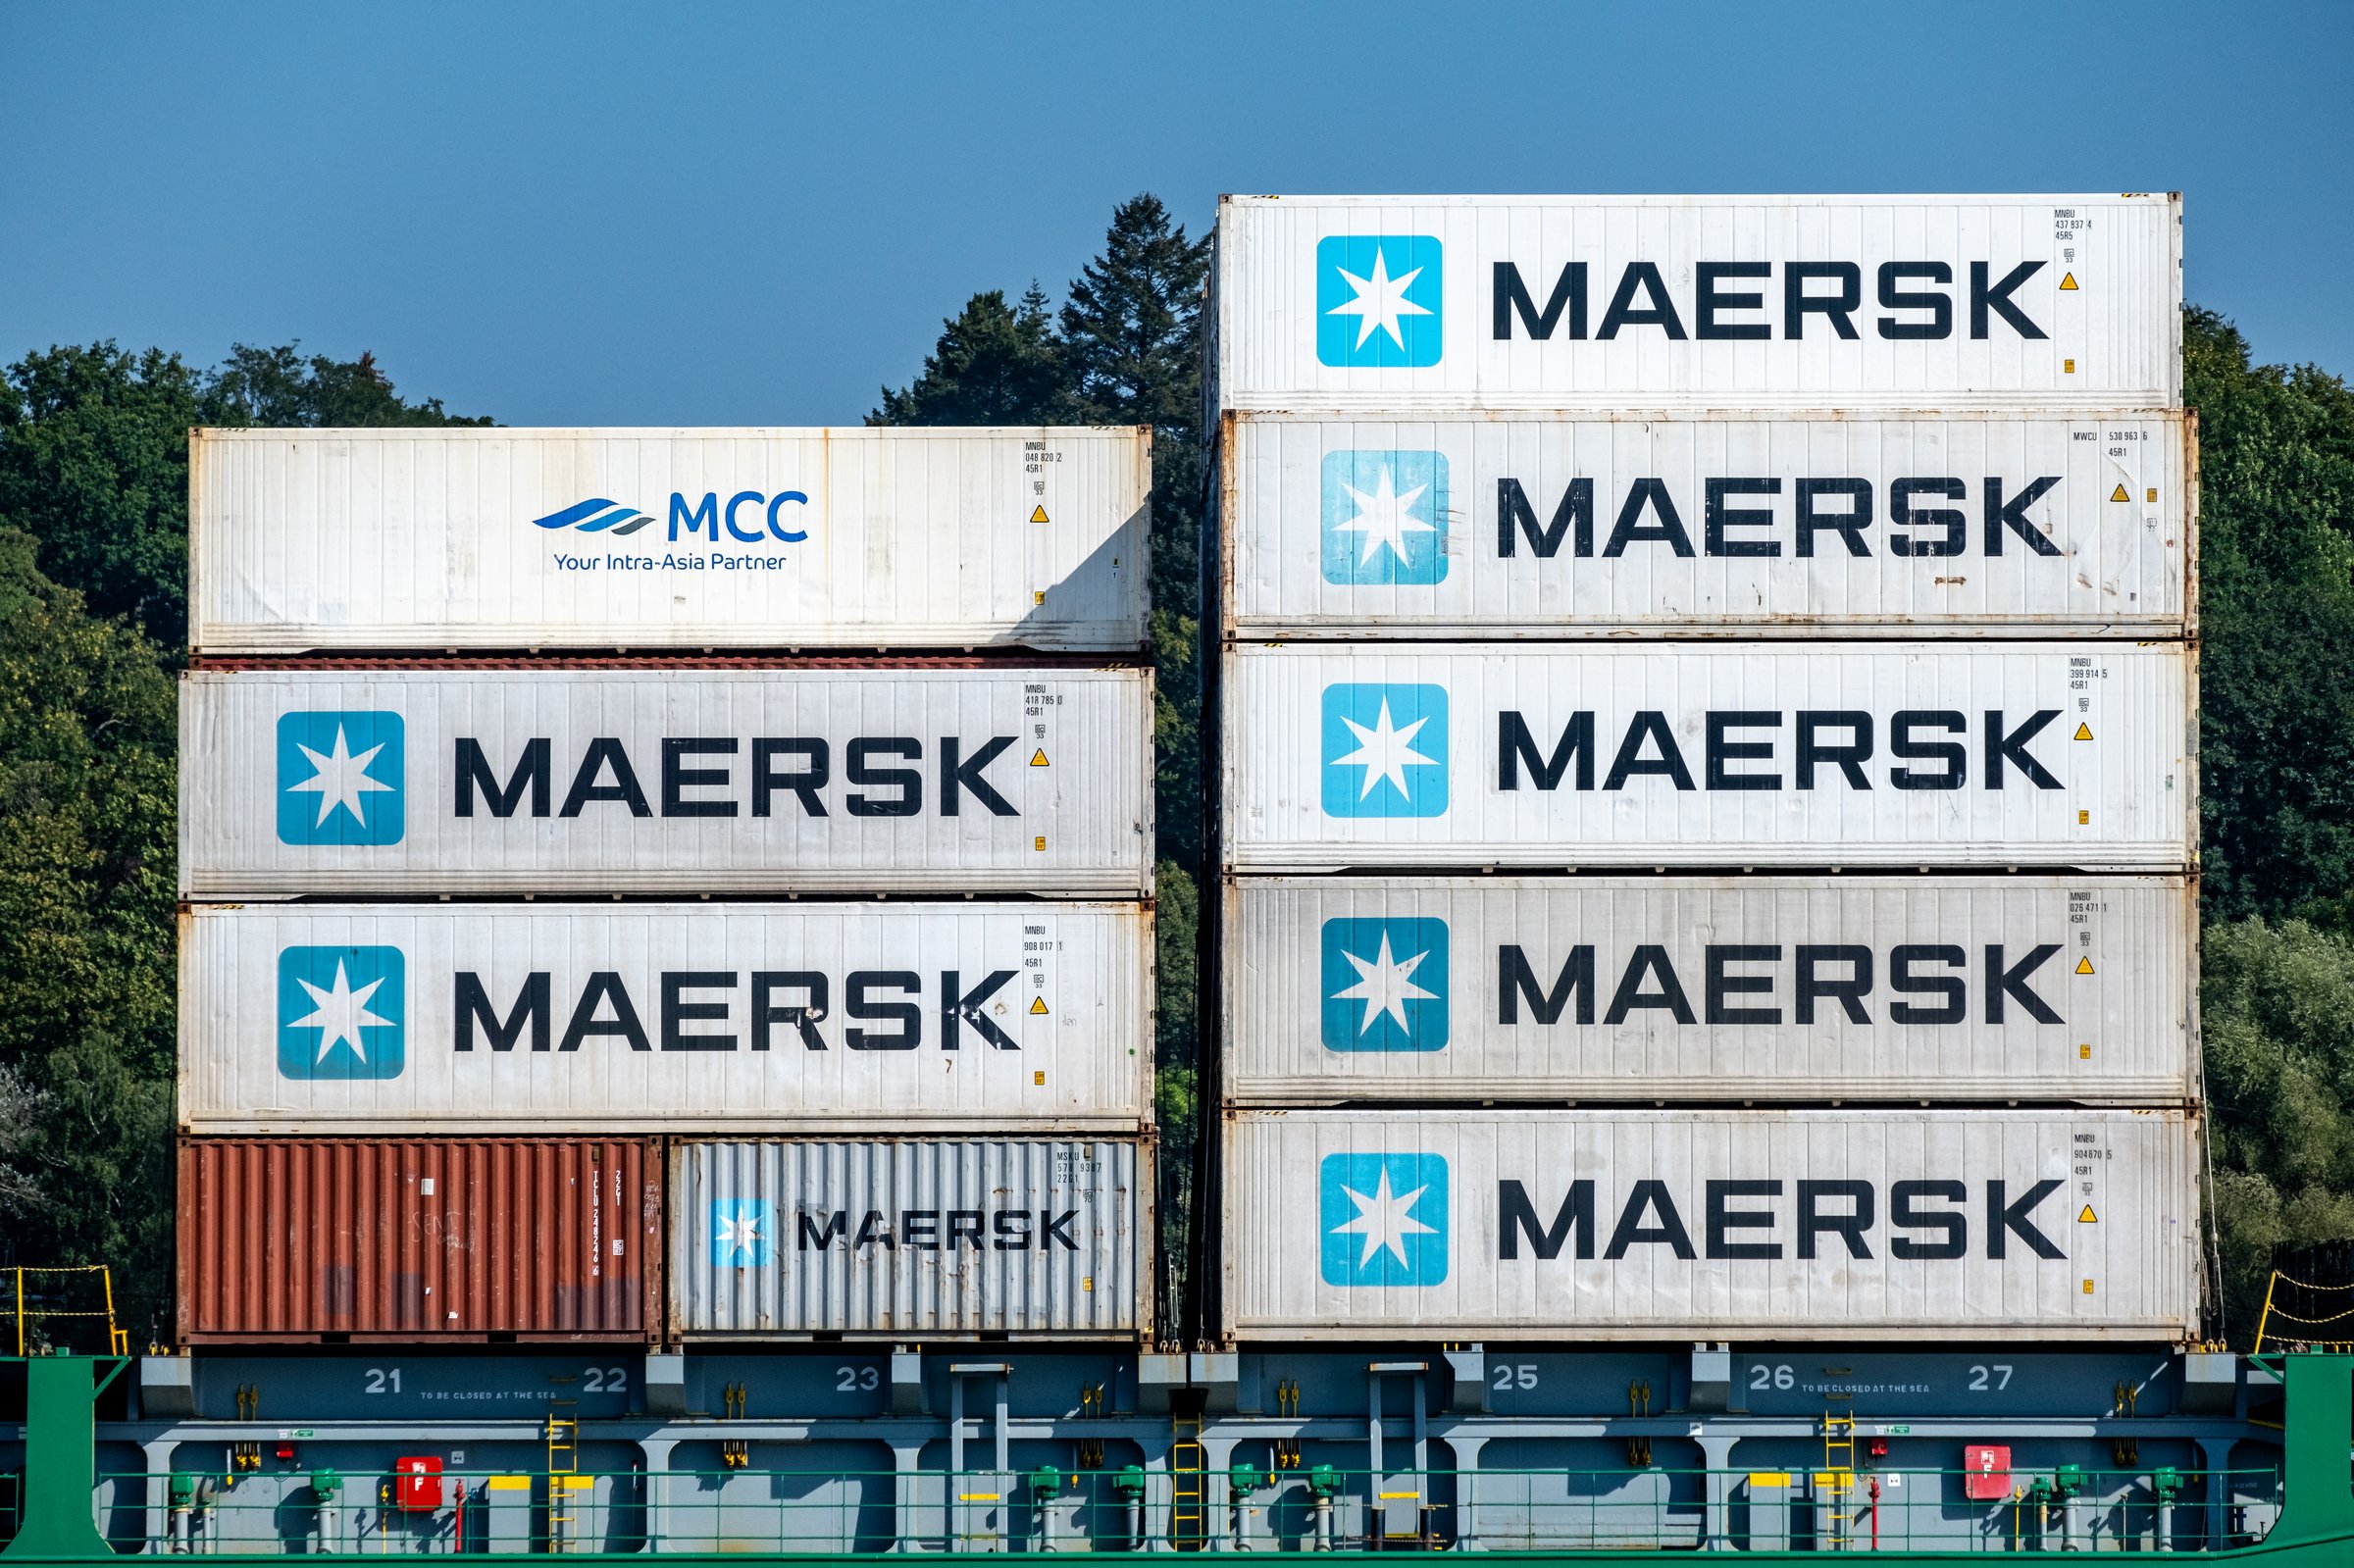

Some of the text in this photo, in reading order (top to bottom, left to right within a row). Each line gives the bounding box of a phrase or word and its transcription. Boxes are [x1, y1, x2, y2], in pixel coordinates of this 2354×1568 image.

[2055, 209, 2074, 218] MNBU
[1494, 262, 2048, 339] MAERSK
[2073, 431, 2097, 440] MWCU
[2109, 431, 2123, 440] 530
[2124, 431, 2137, 440] 963
[1026, 441, 1046, 450] MNBU
[1026, 453, 1038, 462] 048
[1041, 453, 1053, 462] 820
[1026, 464, 1043, 473] 45R1
[668, 491, 808, 542] MCC
[1499, 477, 2062, 557] MAERSK
[554, 553, 787, 570] Your Intra-Asia Partner
[2071, 658, 2091, 667] MNBU
[2071, 669, 2083, 678] 399
[2085, 669, 2099, 678] 914
[1026, 684, 1046, 693] MNBU
[2071, 681, 2088, 689] 45R1
[1042, 695, 1054, 704] 785
[1026, 707, 1044, 716] 45R1
[1499, 710, 2065, 790] MAERSK
[455, 736, 1020, 817] MAERSK
[2071, 892, 2090, 901] MNBU
[2071, 903, 2083, 912] 026
[2086, 903, 2098, 912] 471
[1025, 926, 1046, 935] MNBU
[1024, 941, 1038, 950] 908
[1040, 941, 1052, 950] 017
[1025, 958, 1042, 967] 45R1
[1500, 944, 2066, 1025] MAERSK
[455, 971, 1020, 1051] MAERSK
[1057, 1152, 1079, 1161] MSKU
[2074, 1149, 2102, 1159] 904670
[1058, 1163, 1073, 1172] 578
[2074, 1166, 2092, 1175] 45R1
[1500, 1180, 2066, 1259] MAERSK
[798, 1210, 1080, 1250] MAERSK
[365, 1369, 400, 1393] 21
[584, 1368, 627, 1392] 22
[837, 1367, 879, 1391] 23
[1494, 1365, 1538, 1390] 25
[1751, 1365, 1794, 1390] 26
[1969, 1365, 2013, 1391] 27
